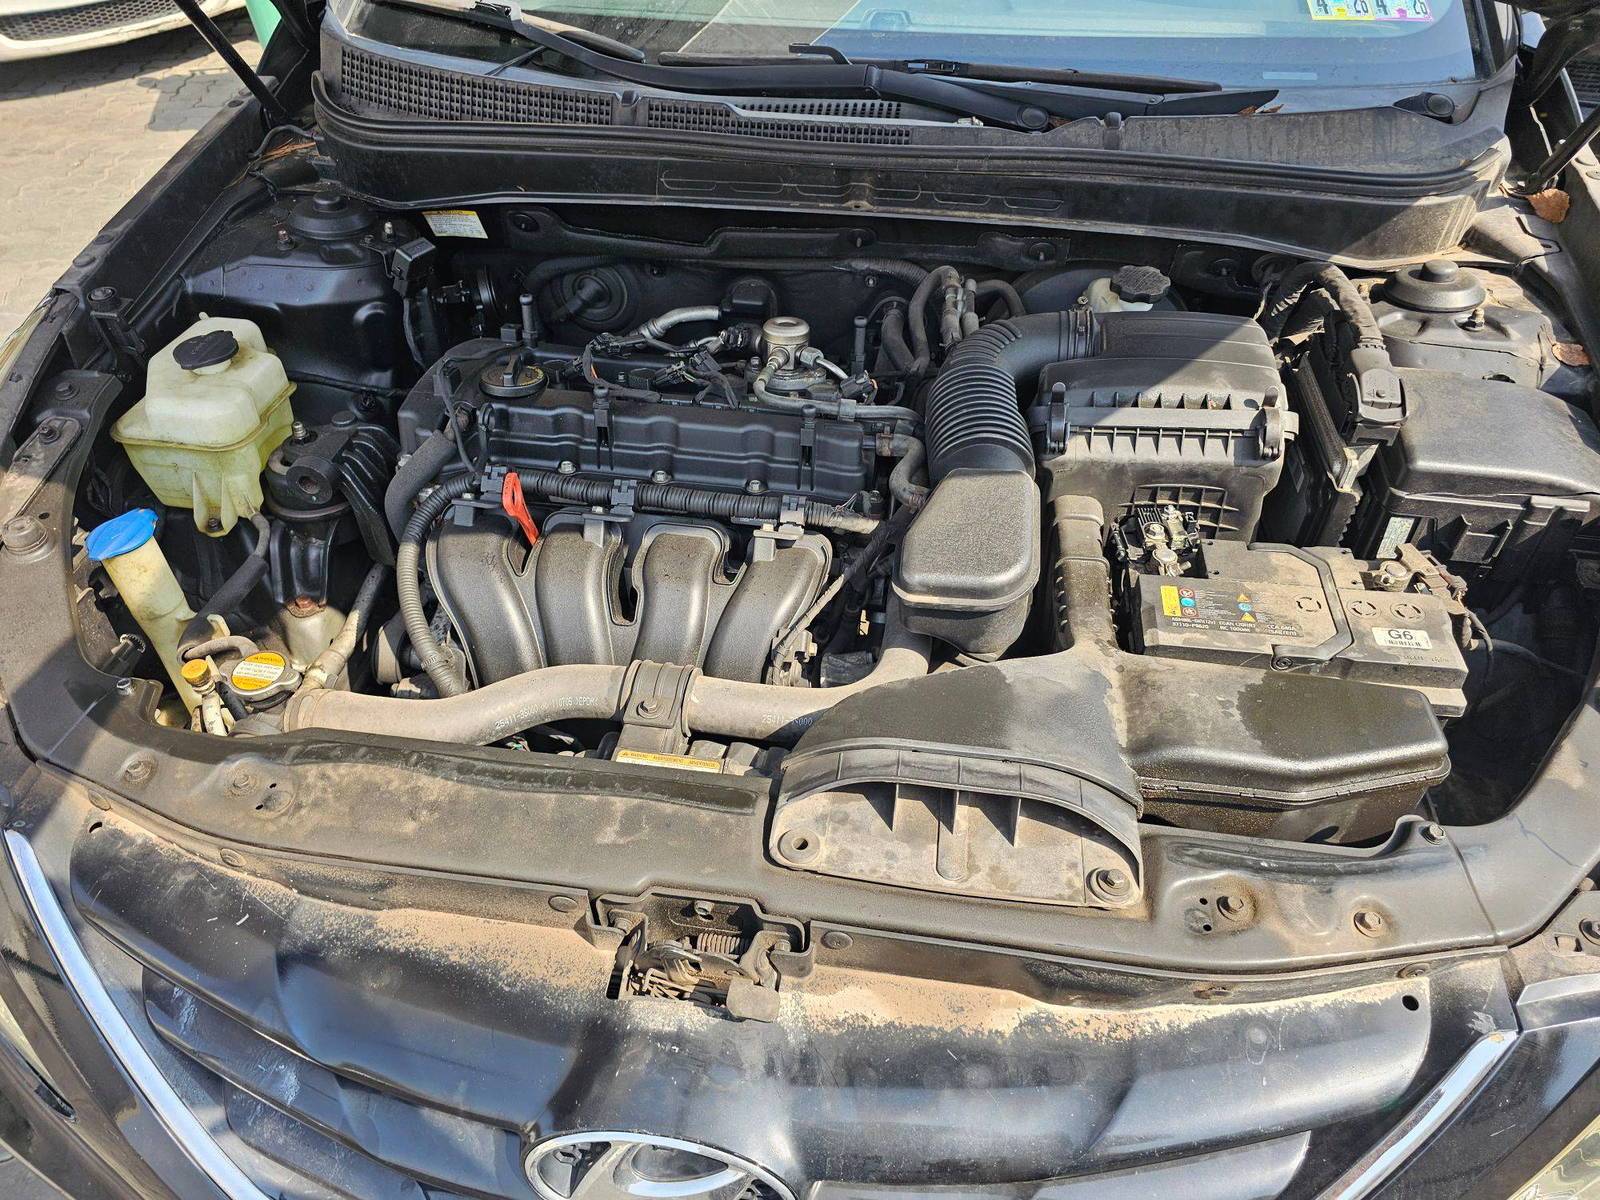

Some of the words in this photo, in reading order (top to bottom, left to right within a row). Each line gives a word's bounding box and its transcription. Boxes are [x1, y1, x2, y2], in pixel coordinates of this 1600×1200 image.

[1317, 0, 1329, 14] 4
[1376, 0, 1389, 15] 4
[1388, 629, 1414, 641] G6
